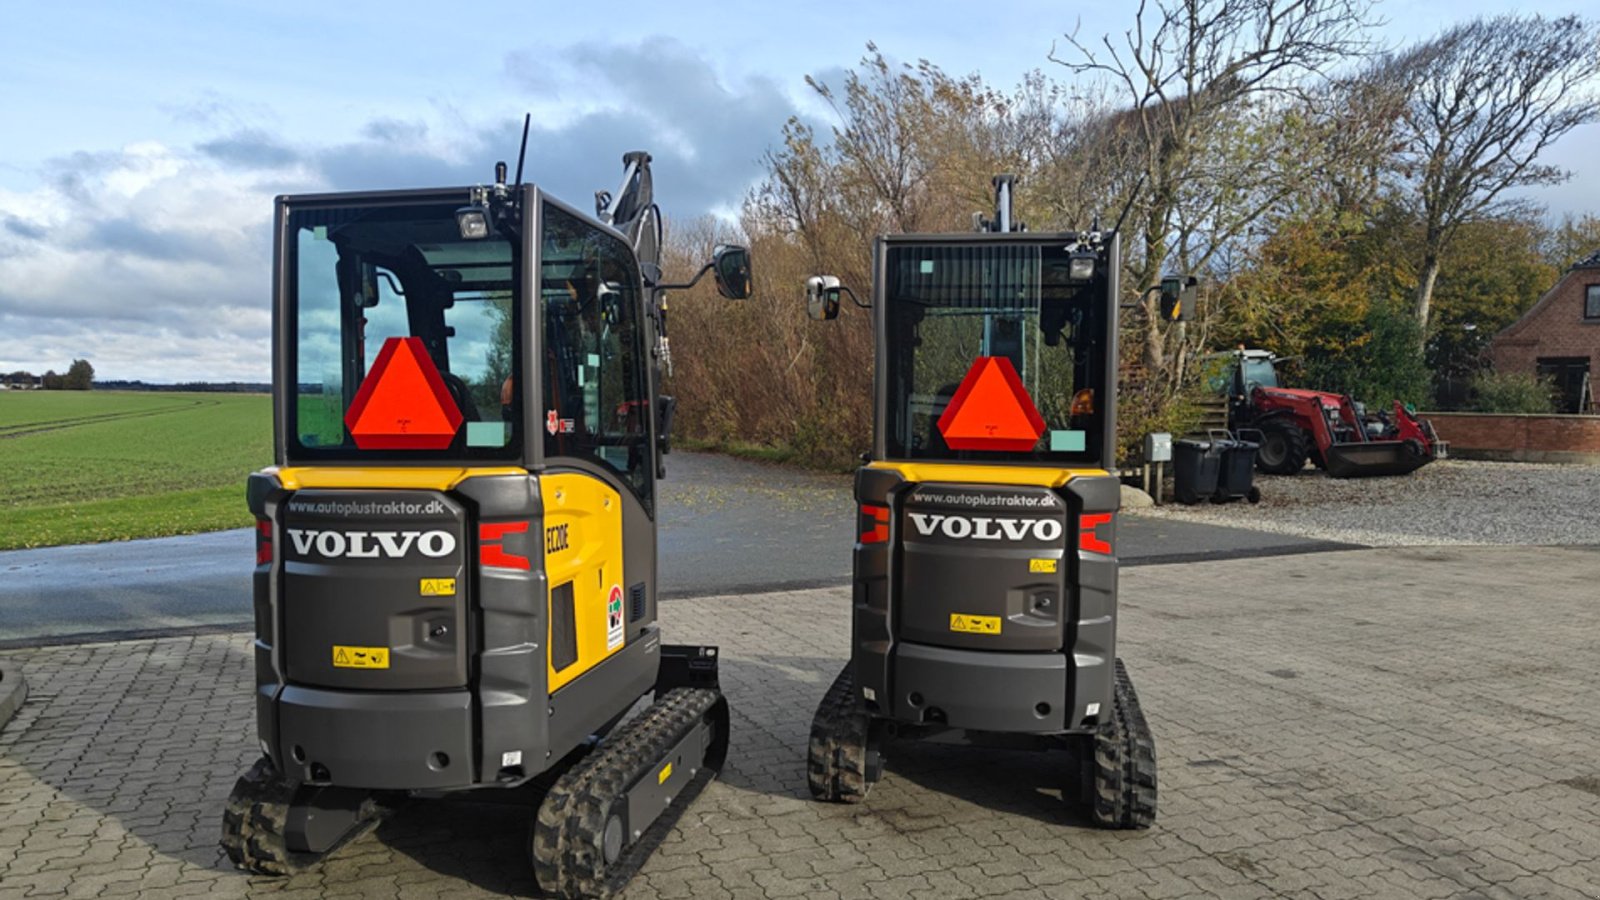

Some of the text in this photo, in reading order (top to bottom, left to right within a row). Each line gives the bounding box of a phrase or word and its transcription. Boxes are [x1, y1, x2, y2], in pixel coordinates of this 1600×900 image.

[288, 500, 444, 516] www.autoplustraktor.dk
[914, 493, 1056, 507] www.autoplustraktor.dk
[547, 523, 568, 554] EC20E
[908, 512, 1062, 541] VOLVO
[287, 528, 456, 558] VOLVO
